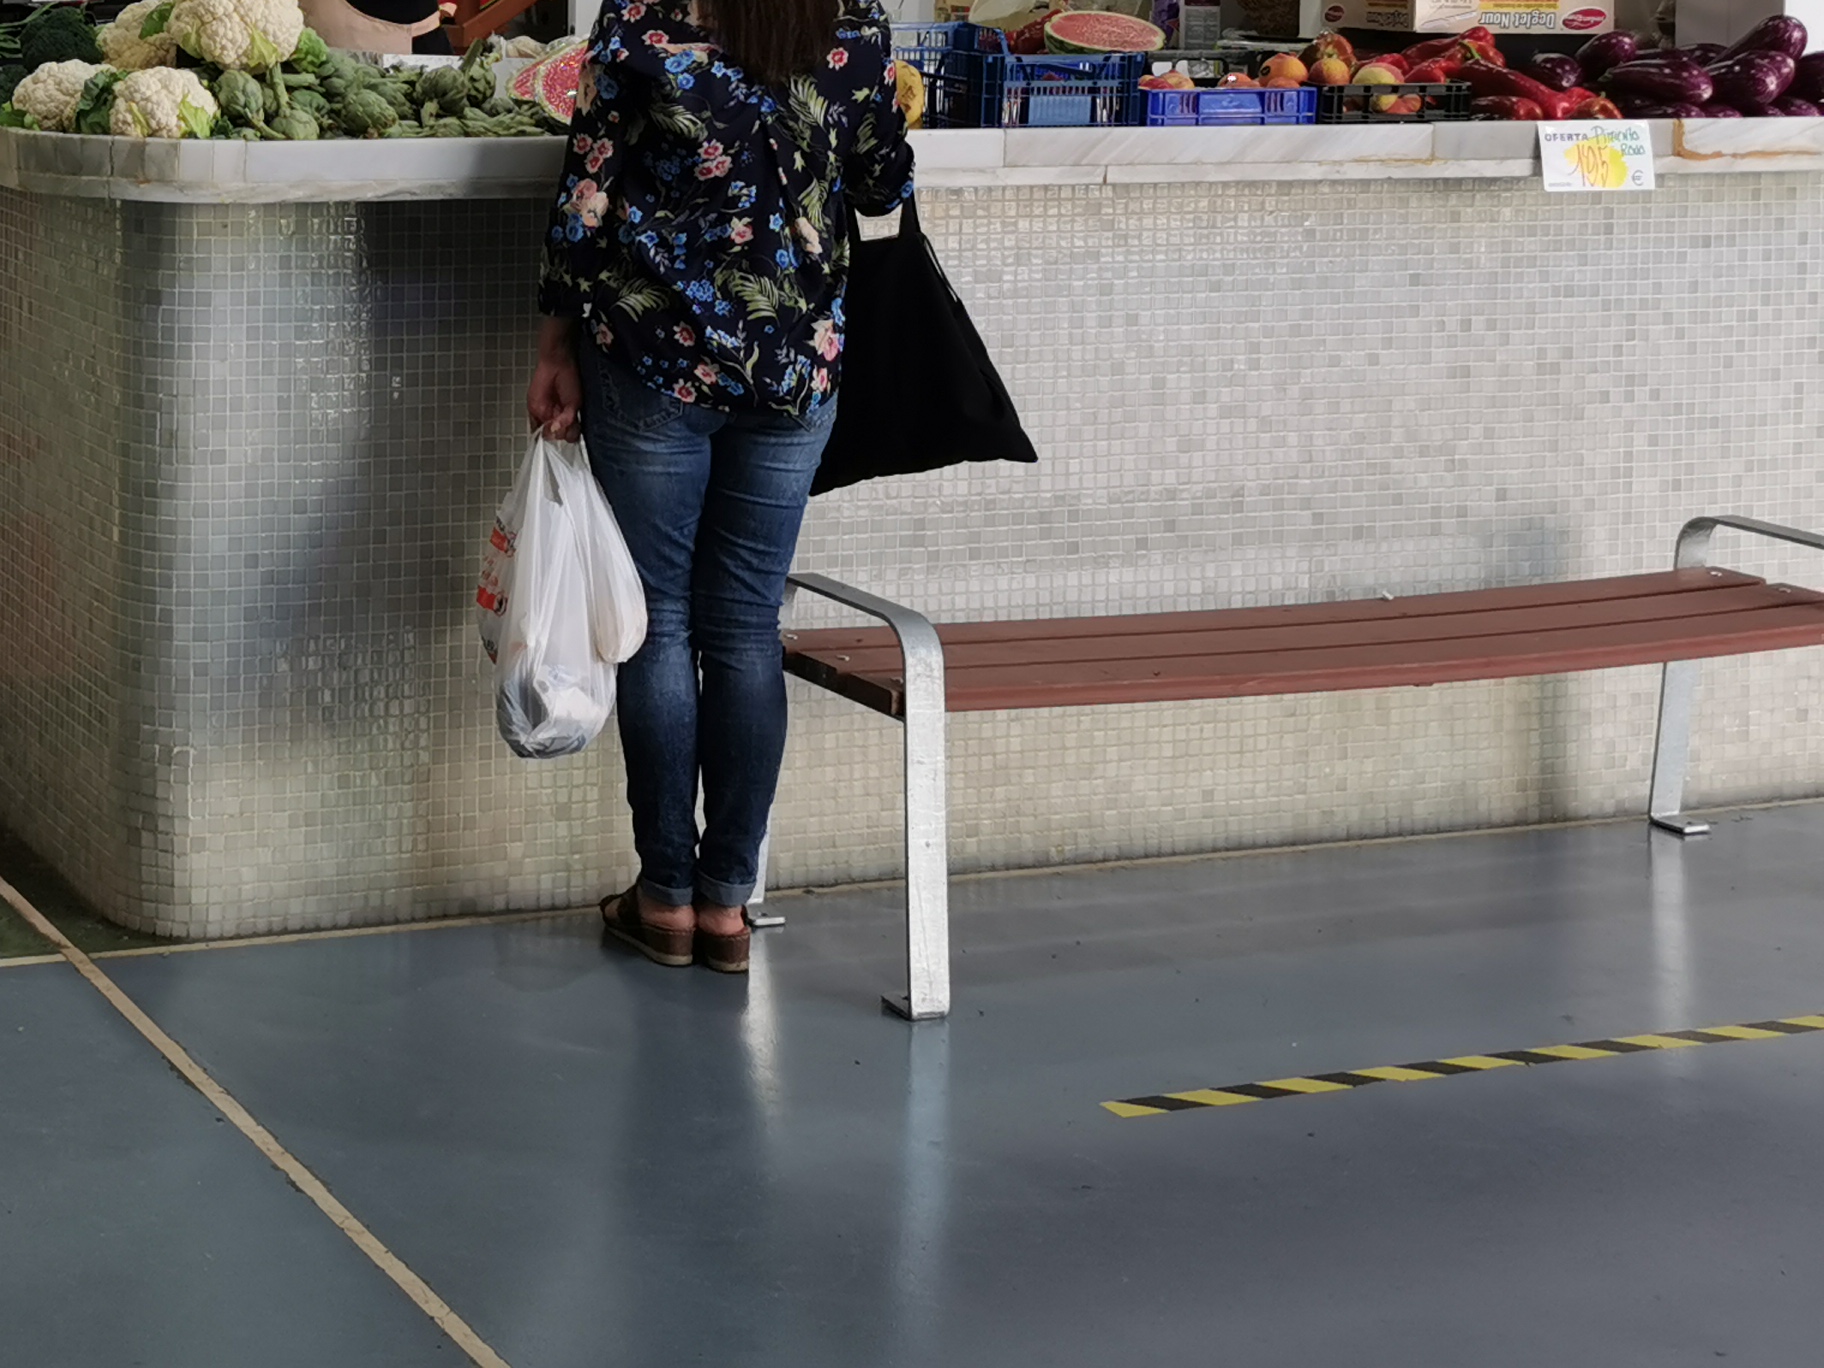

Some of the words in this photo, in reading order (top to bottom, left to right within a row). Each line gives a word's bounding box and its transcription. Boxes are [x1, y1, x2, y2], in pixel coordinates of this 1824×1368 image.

[1478, 11, 1511, 29] Nour
[1514, 8, 1556, 29] Deglet
[1544, 133, 1589, 142] OFERTA
